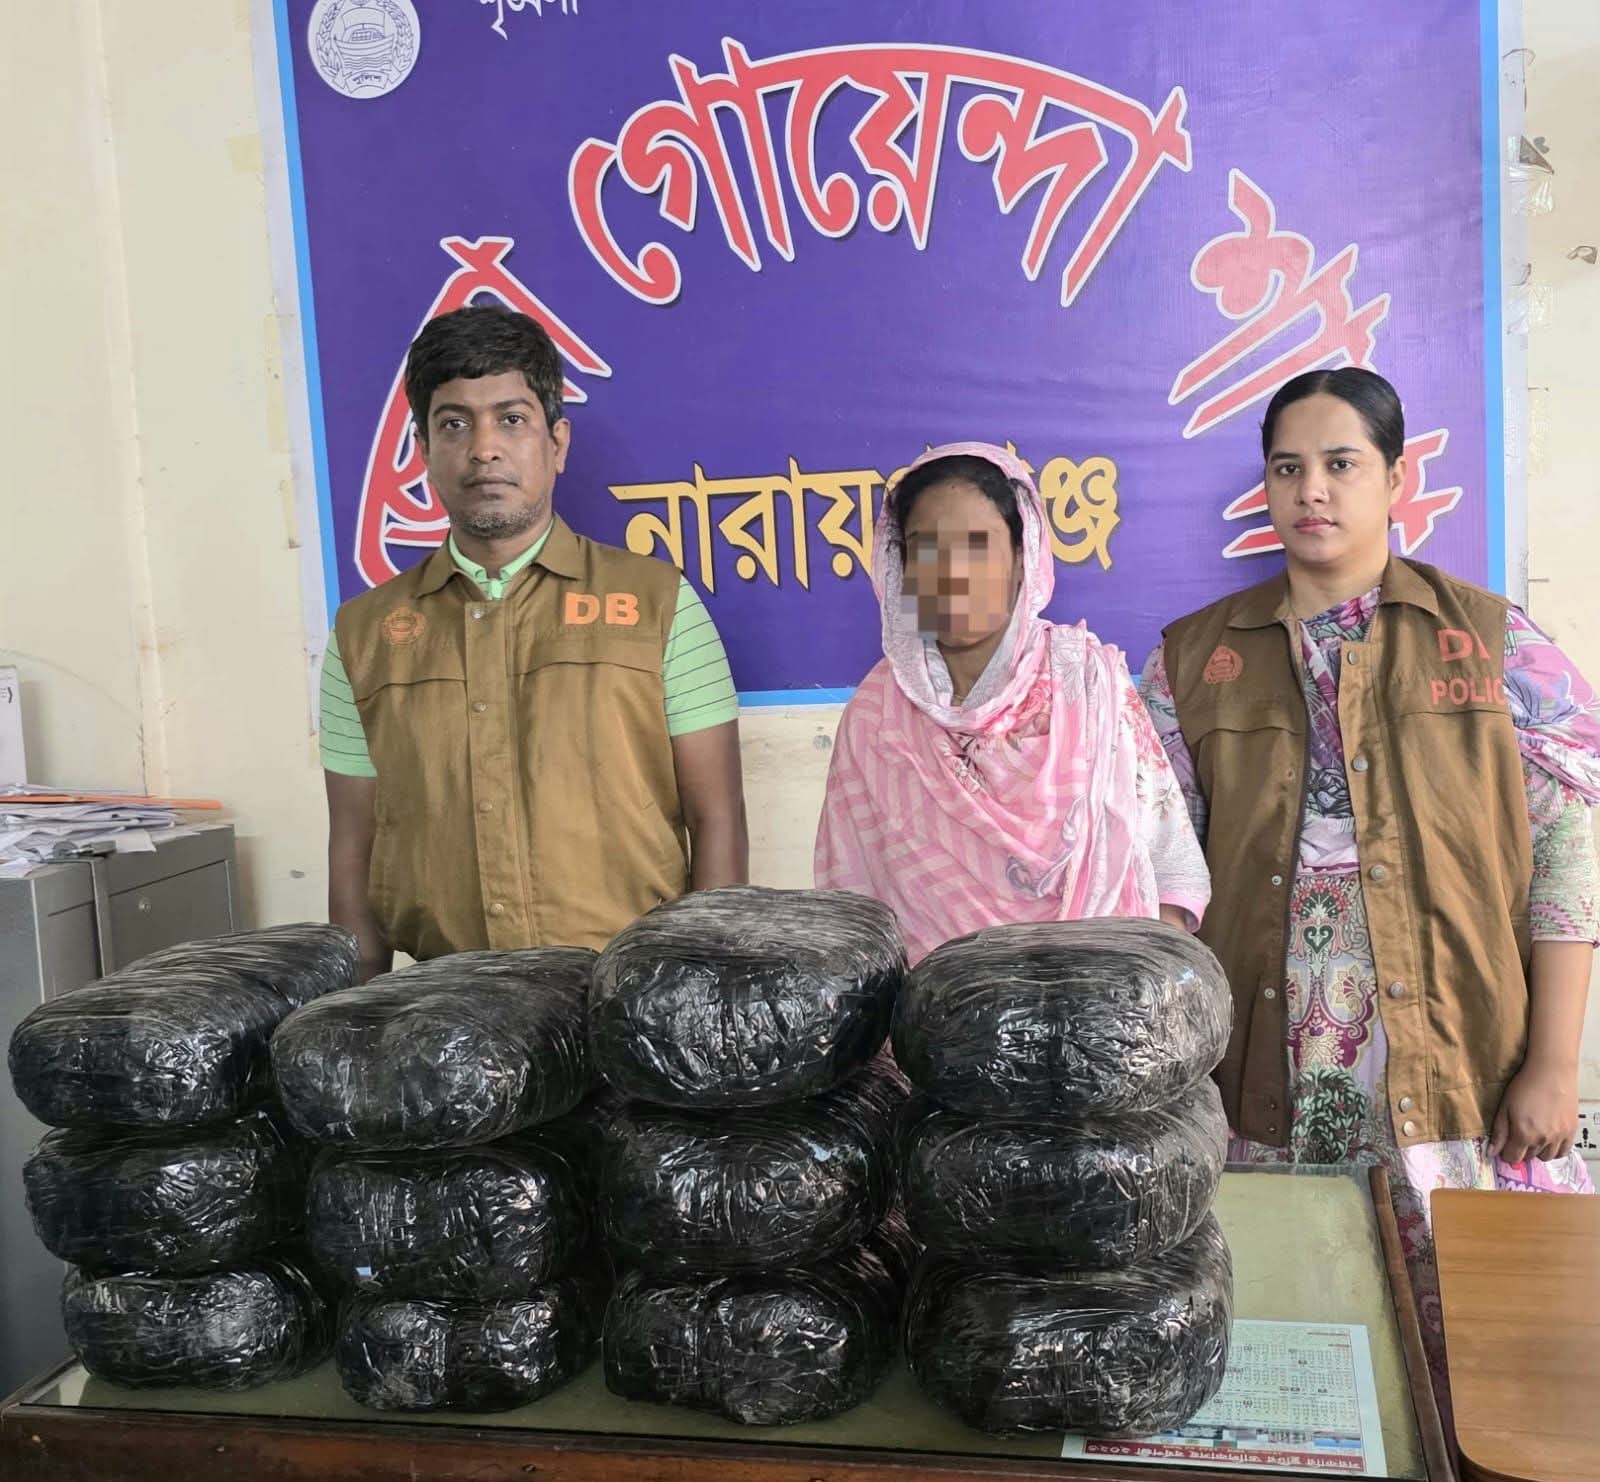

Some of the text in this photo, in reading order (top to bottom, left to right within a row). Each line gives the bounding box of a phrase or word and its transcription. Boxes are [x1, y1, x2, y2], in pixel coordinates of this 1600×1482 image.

[568, 37, 1192, 306] গোয়েন্দা
[607, 440, 1120, 593] নারায়ঞ্জ
[564, 591, 640, 626] DB
